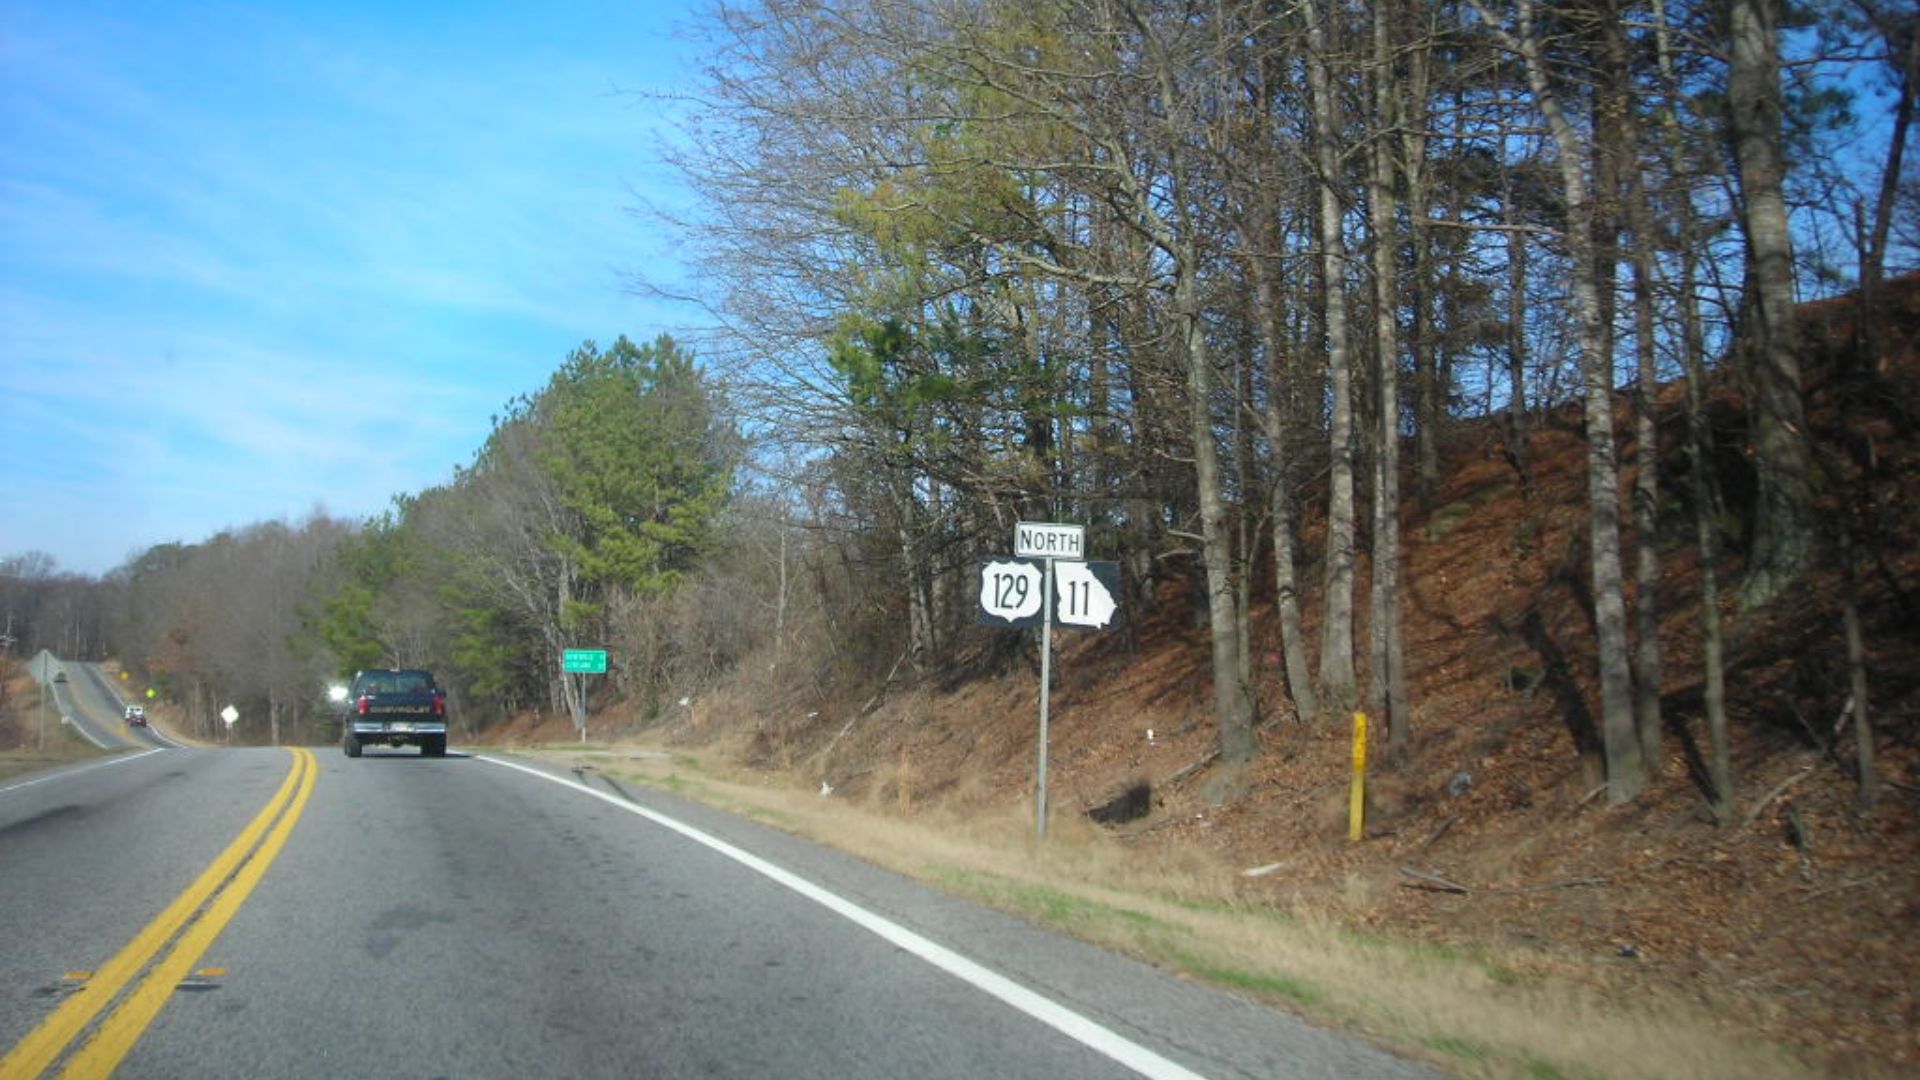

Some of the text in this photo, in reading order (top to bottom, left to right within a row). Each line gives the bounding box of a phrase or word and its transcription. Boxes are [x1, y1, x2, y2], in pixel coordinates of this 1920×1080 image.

[1020, 531, 1079, 552] NORTH
[994, 573, 1028, 609] 129
[1069, 581, 1089, 616] 11
